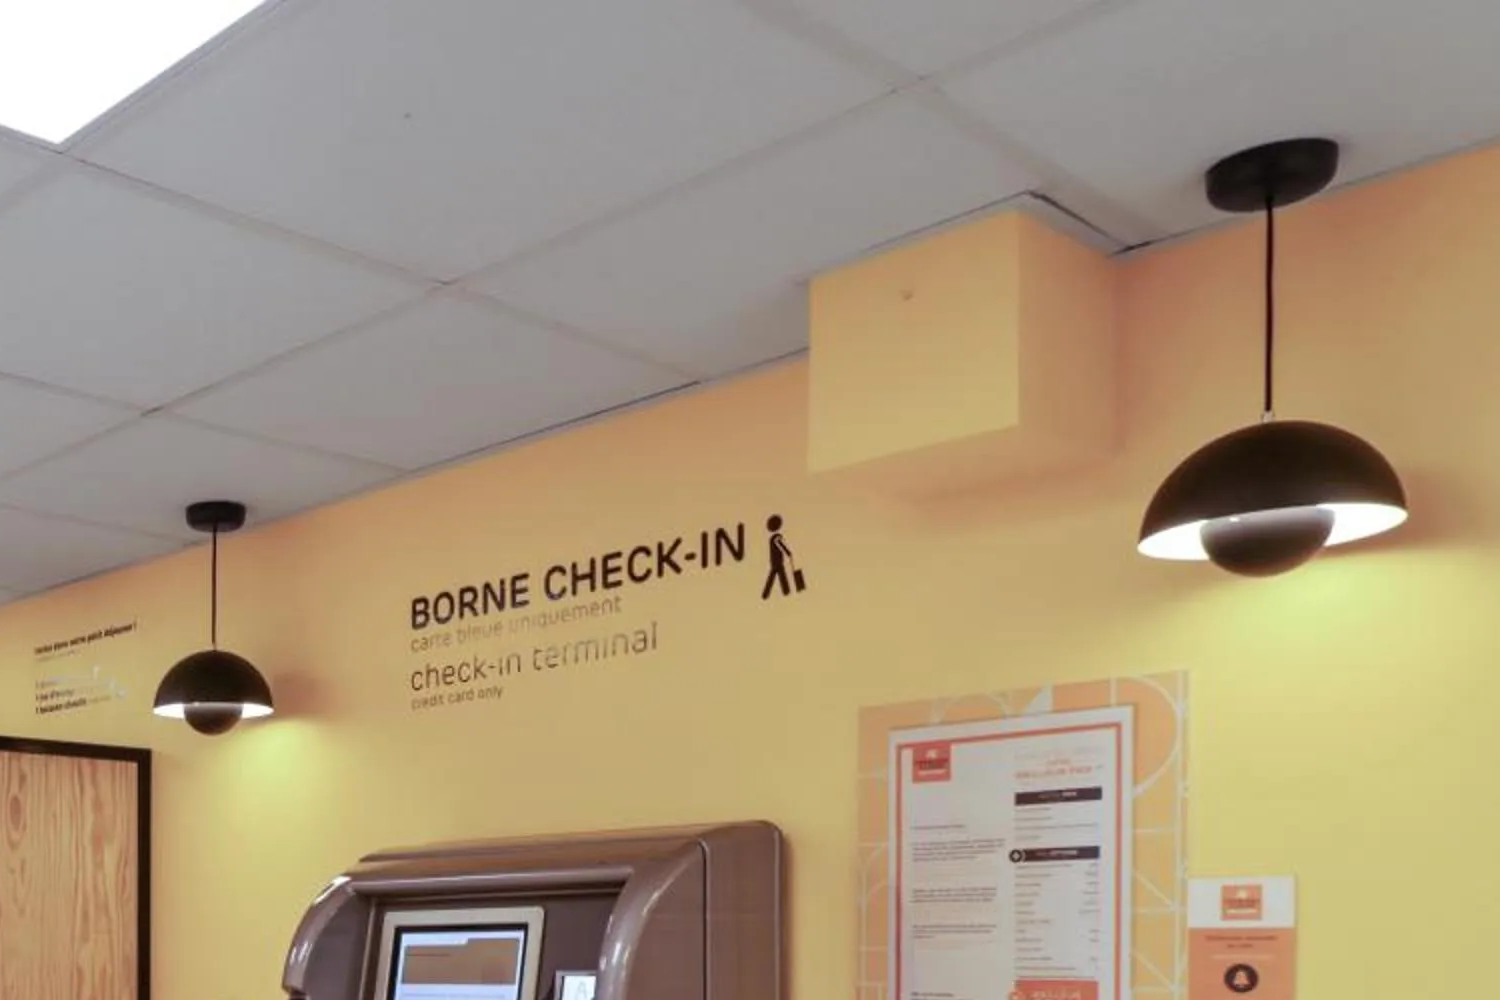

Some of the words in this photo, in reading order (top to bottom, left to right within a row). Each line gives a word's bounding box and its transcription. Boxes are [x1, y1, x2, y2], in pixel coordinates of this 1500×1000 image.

[410, 572, 530, 630] BORNE
[543, 522, 746, 601] CHECK-IN
[410, 632, 451, 653] carte
[456, 620, 504, 644] bleue
[508, 595, 623, 635] uniquement
[410, 652, 522, 691] check-in
[532, 620, 659, 671] terminal
[410, 693, 445, 711] credit
[447, 688, 475, 706] card
[477, 684, 504, 701] only
